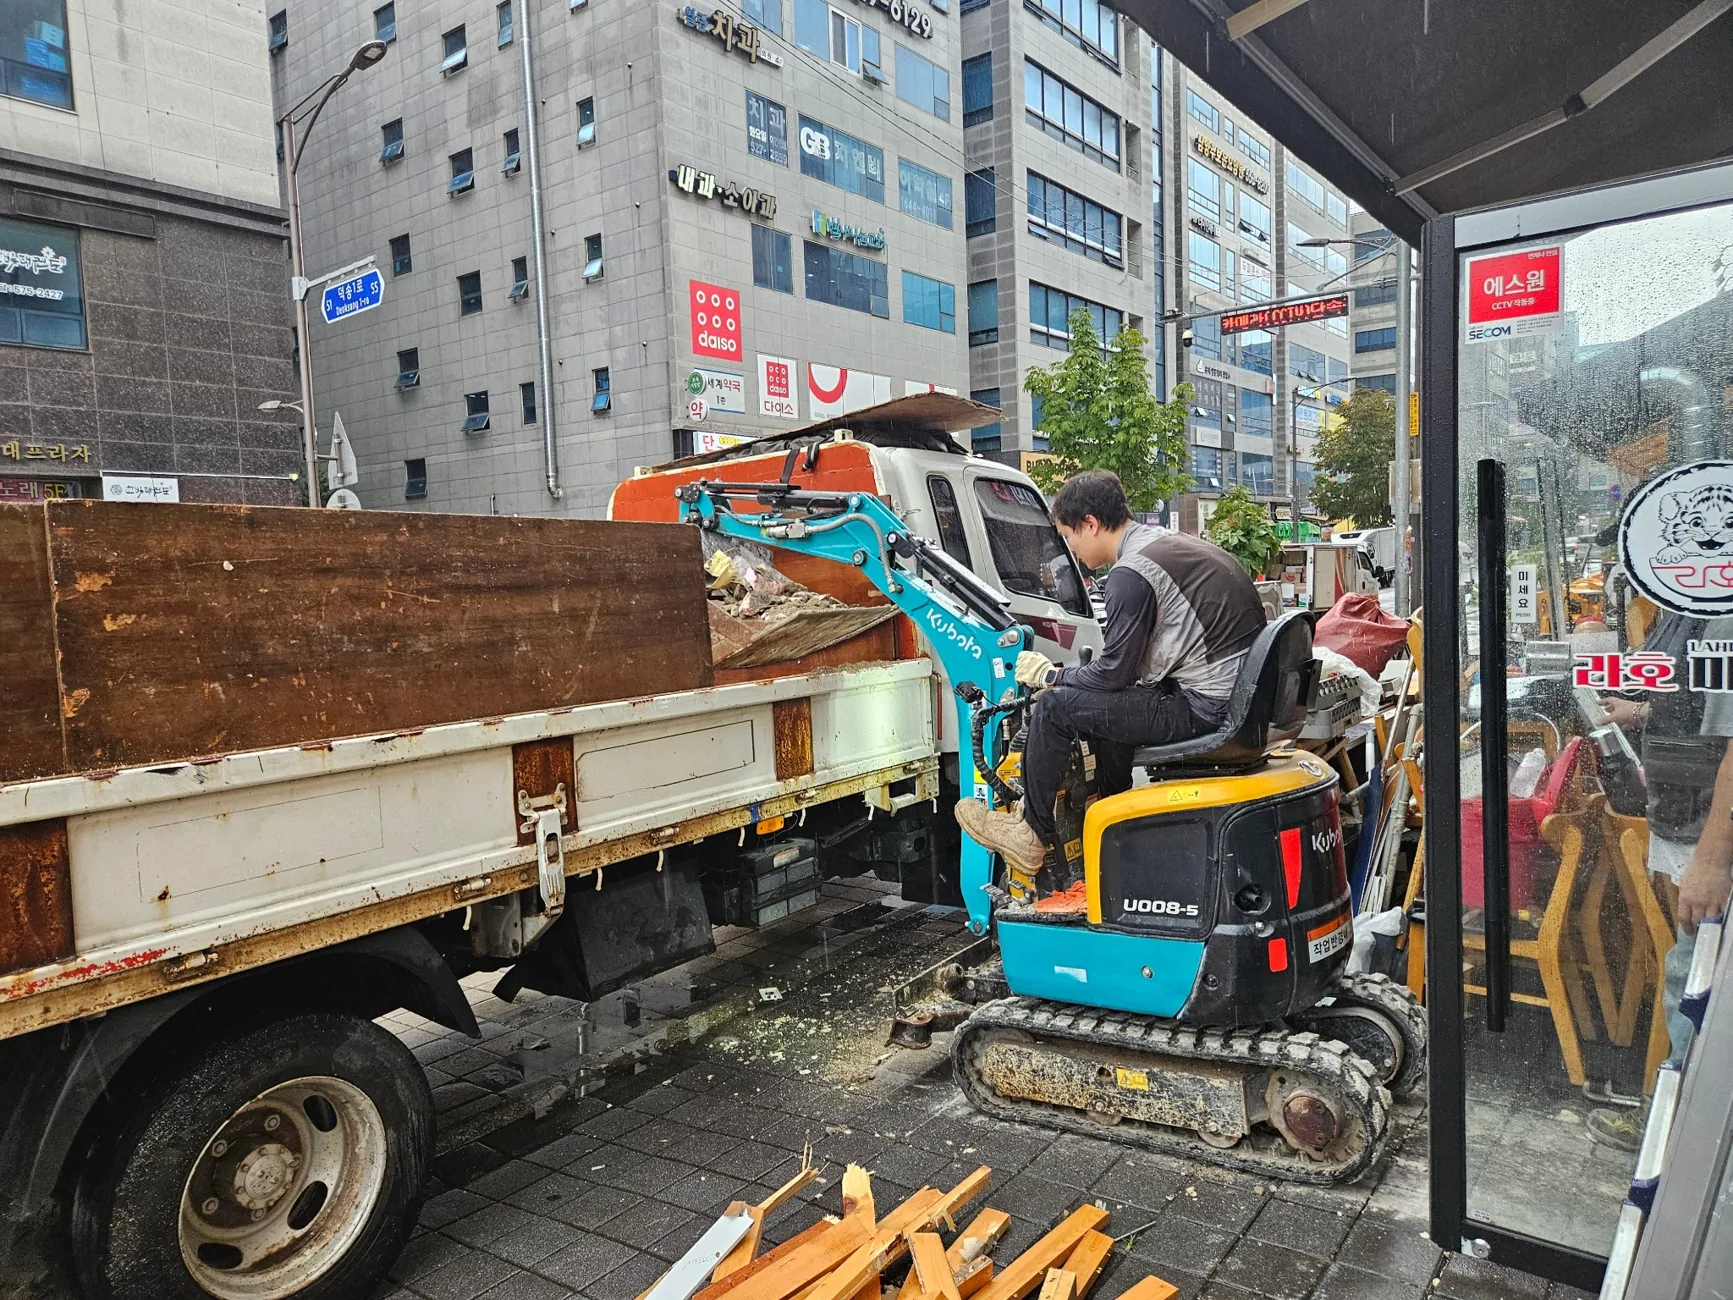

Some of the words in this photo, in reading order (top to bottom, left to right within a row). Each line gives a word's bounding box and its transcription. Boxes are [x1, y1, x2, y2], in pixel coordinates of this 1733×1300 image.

[869, 0, 931, 38] -6129
[748, 97, 785, 137] 치과
[678, 163, 777, 220] 내과·소아과
[1527, 250, 1545, 260] 언제나
[1545, 249, 1558, 257] 안심
[337, 278, 364, 301] 덕송1로
[370, 281, 379, 295] 55
[1483, 269, 1545, 297] 에스원
[325, 298, 333, 312] 51
[335, 300, 359, 316] Deoksong
[359, 296, 370, 307] 1-ro
[1491, 300, 1513, 311] CCTV
[1513, 297, 1536, 307] 작동중
[698, 330, 737, 352] daiso
[1468, 325, 1511, 340] SECOM
[707, 378, 741, 393] 세계약국
[769, 385, 787, 395] daiso
[690, 400, 704, 419] 약
[763, 400, 794, 415] 다이소
[1, 440, 92, 463] 대프라자
[0, 481, 39, 499] 노래
[44, 483, 66, 500] 5F
[1517, 571, 1528, 608] 미세요
[926, 608, 983, 660] Kubota
[1575, 653, 1677, 690] 라호
[1123, 898, 1199, 916] U008-5
